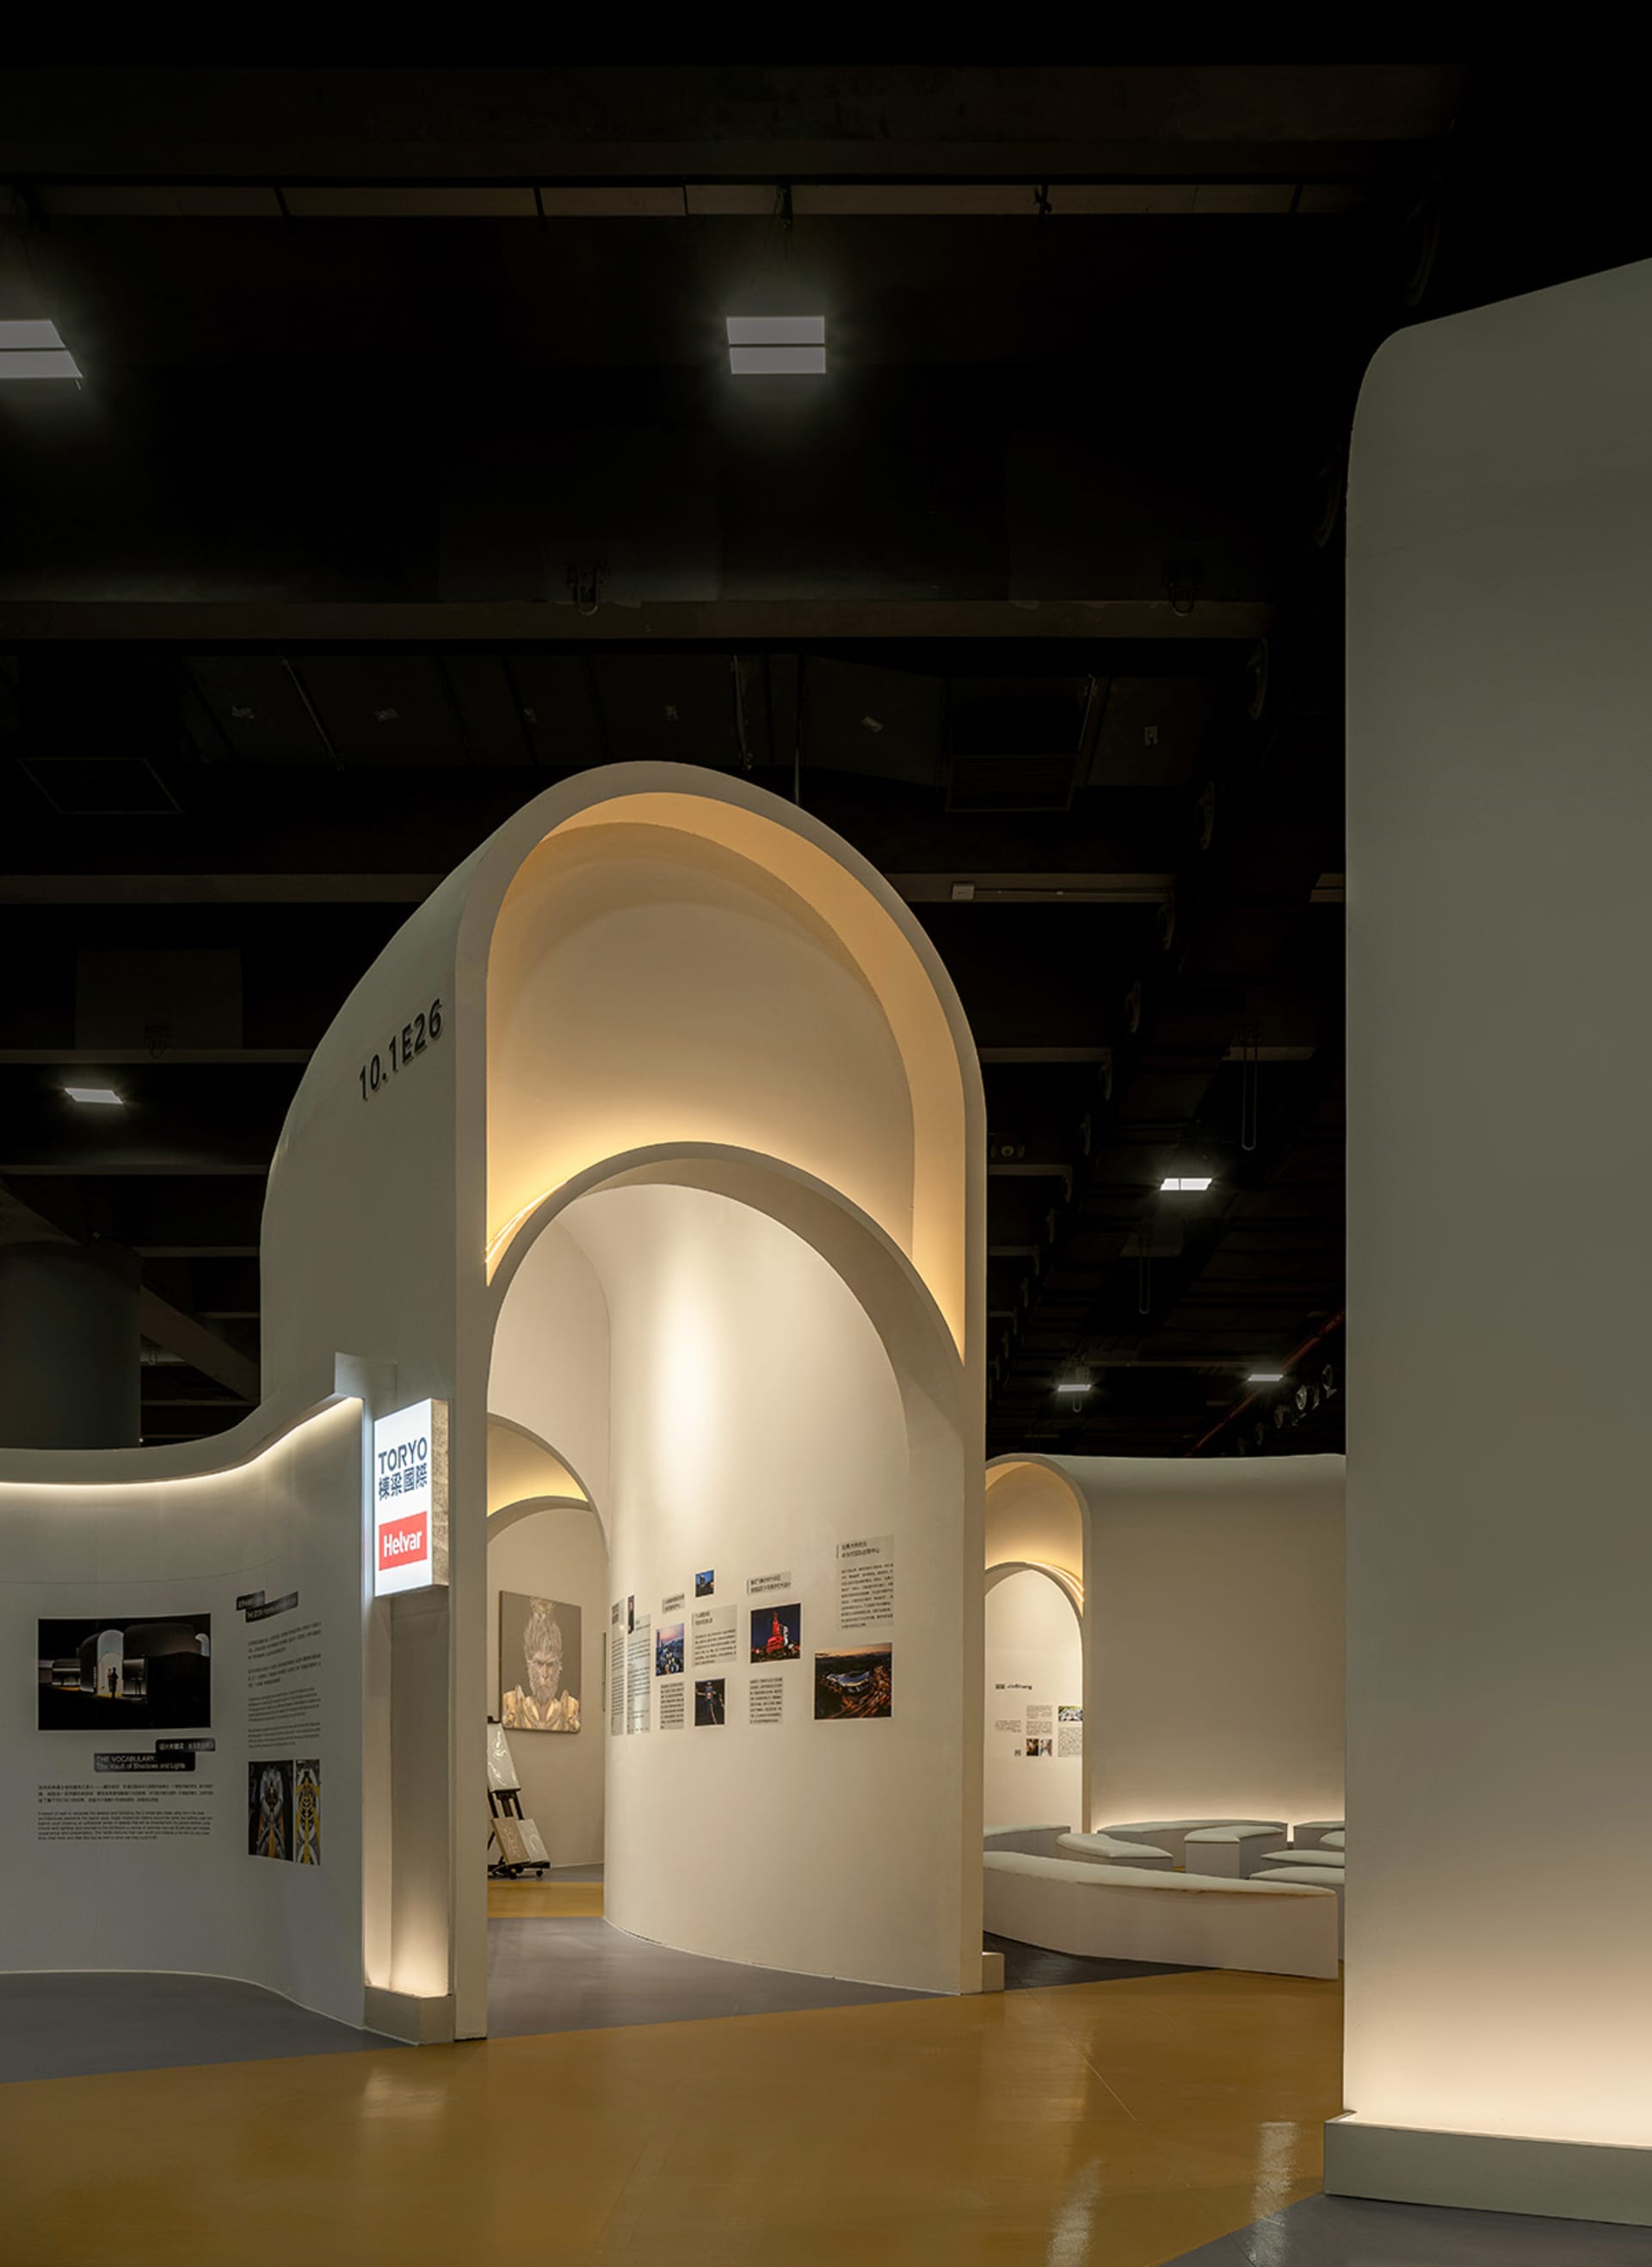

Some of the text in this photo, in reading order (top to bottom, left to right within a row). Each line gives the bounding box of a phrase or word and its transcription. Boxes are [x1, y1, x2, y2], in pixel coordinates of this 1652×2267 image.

[360, 998, 441, 1101] 10.1E26
[379, 1436, 428, 1474] TORYO
[379, 1462, 428, 1501] 棟梁國際
[384, 1530, 422, 1557] Helvar
